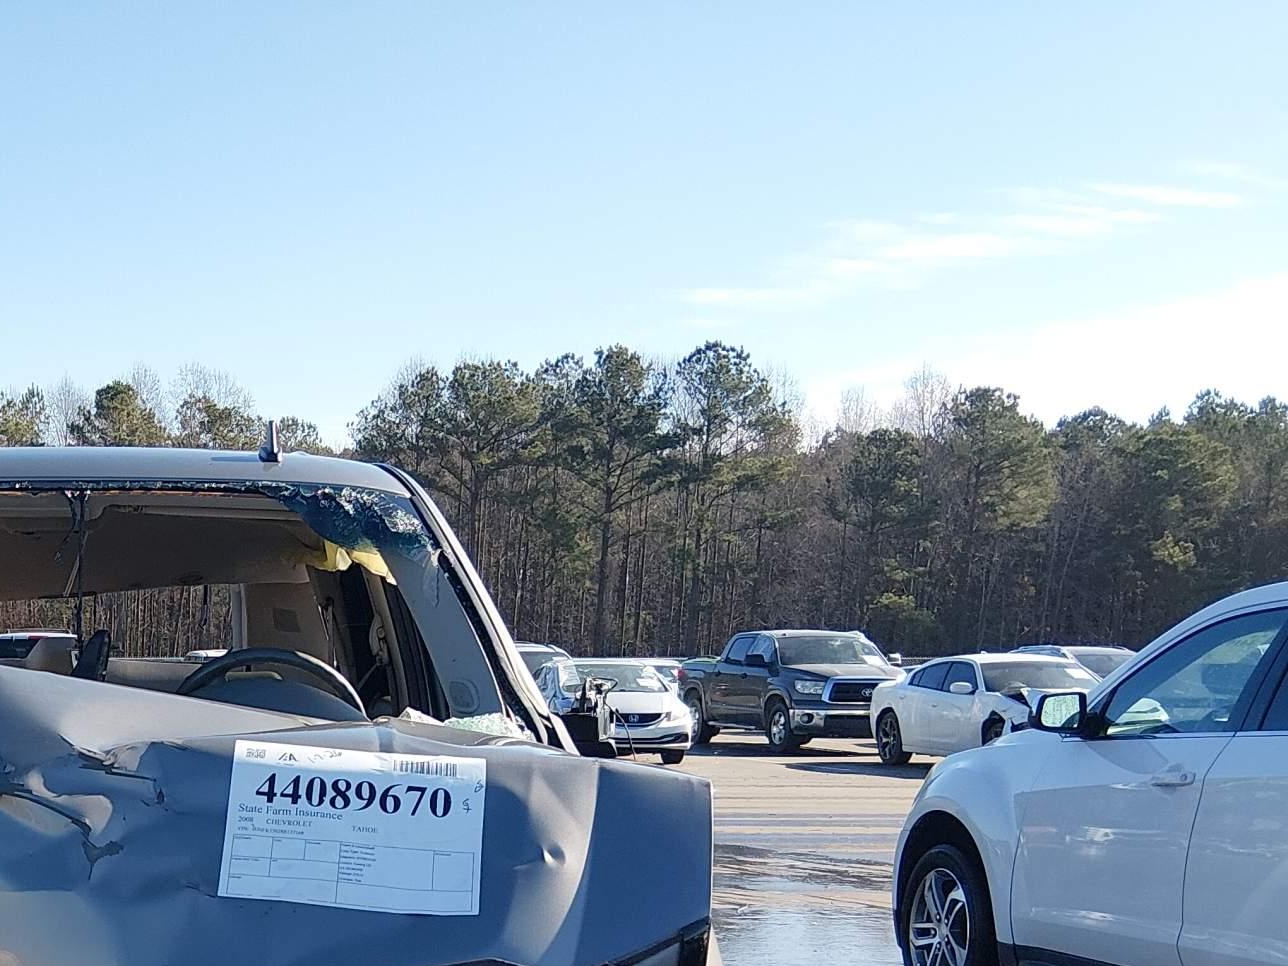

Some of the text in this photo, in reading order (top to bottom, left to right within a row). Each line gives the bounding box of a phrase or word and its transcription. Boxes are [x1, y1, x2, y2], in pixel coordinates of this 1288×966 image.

[255, 773, 452, 817] 44089670
[237, 802, 344, 821] State Farm Insurance
[266, 818, 313, 828] CHEVROLET
